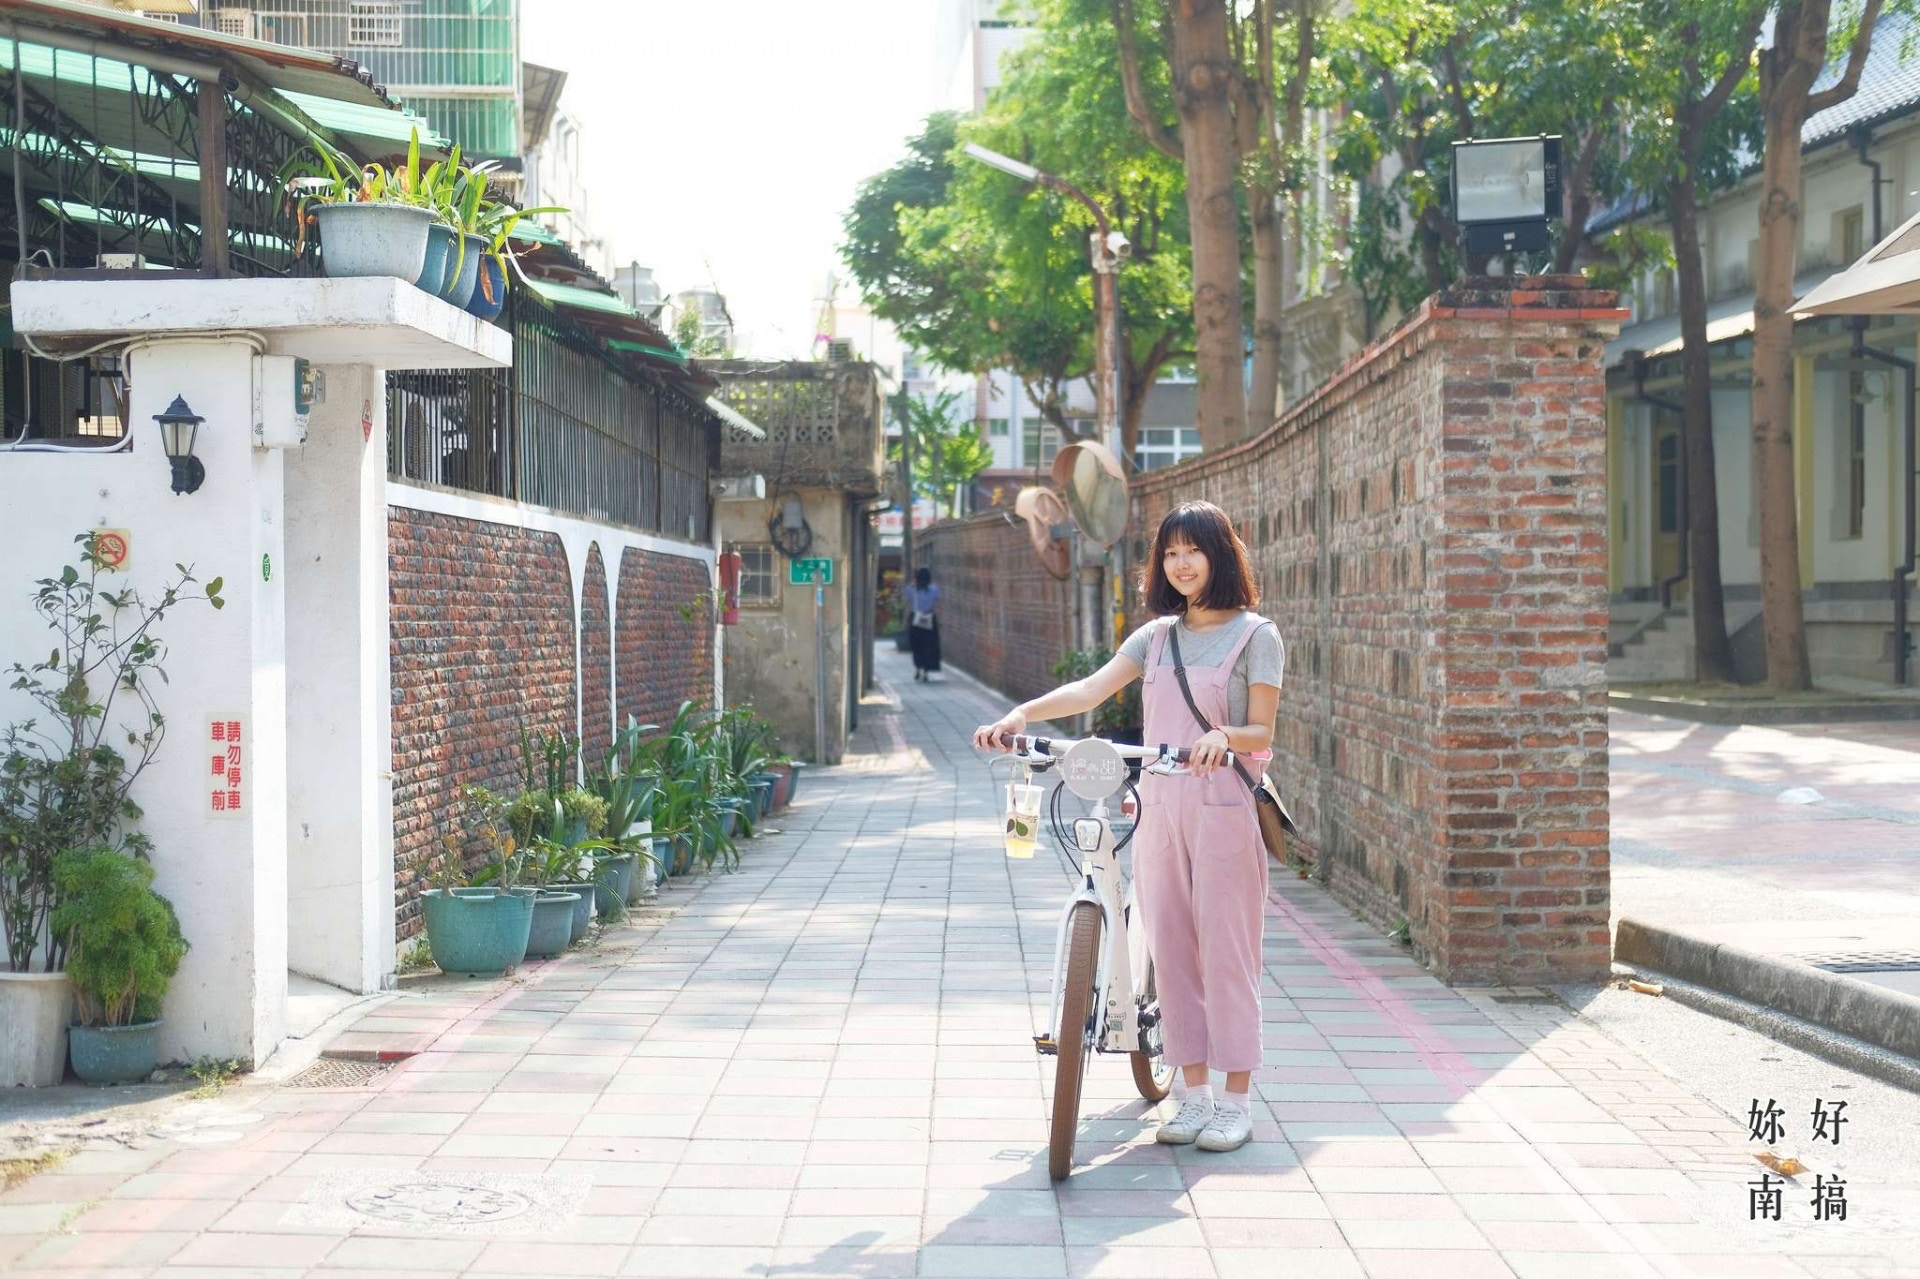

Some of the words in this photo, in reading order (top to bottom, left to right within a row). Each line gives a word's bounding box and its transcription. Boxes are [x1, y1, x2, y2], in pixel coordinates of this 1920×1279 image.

[211, 721, 226, 811] 車庫前
[227, 721, 242, 811] 請勿停車
